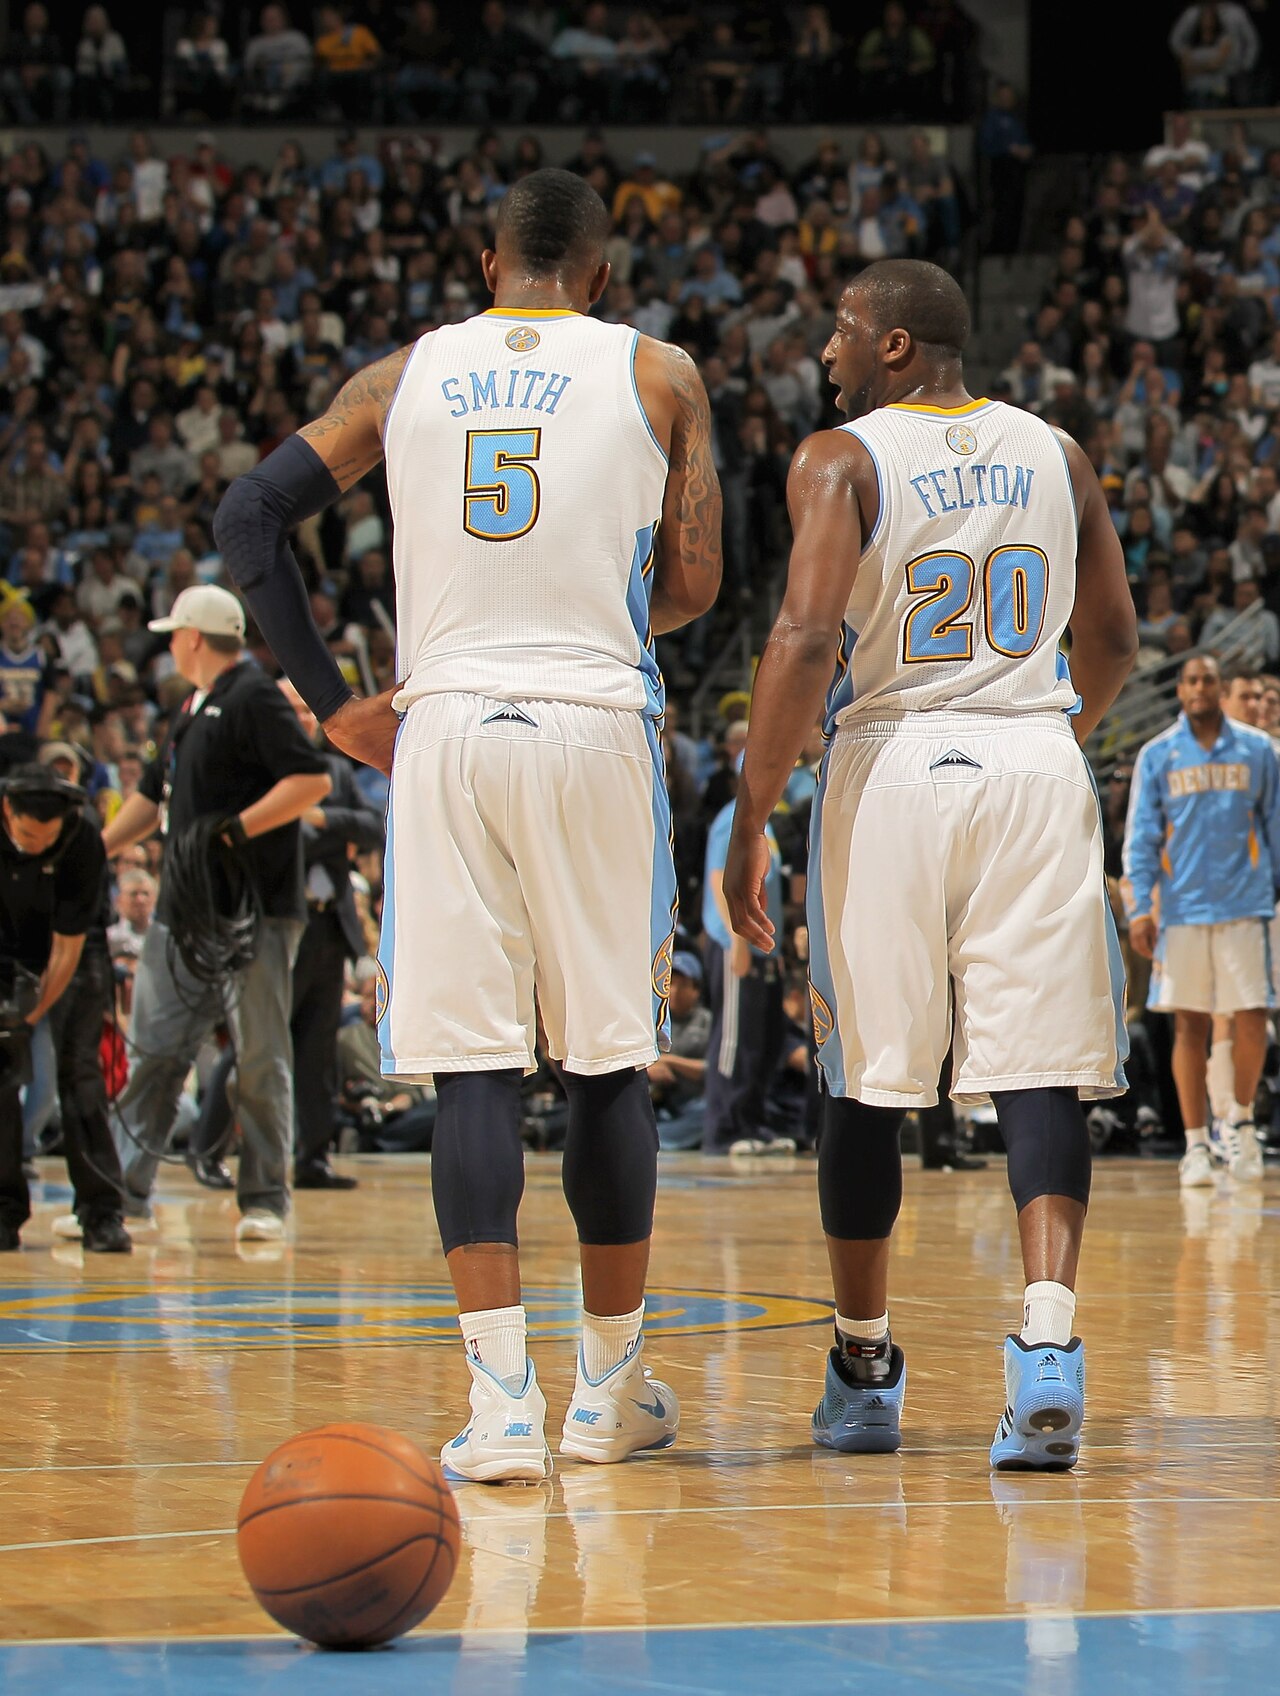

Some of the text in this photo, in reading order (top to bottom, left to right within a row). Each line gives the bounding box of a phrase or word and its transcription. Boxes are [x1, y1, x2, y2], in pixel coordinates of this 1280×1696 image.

[441, 370, 572, 417] SMITH
[463, 427, 542, 542] 5
[910, 464, 1034, 518] FELTON
[902, 544, 1049, 664] 20
[1167, 763, 1250, 799] DENVER
[572, 1408, 603, 1425] NIKE
